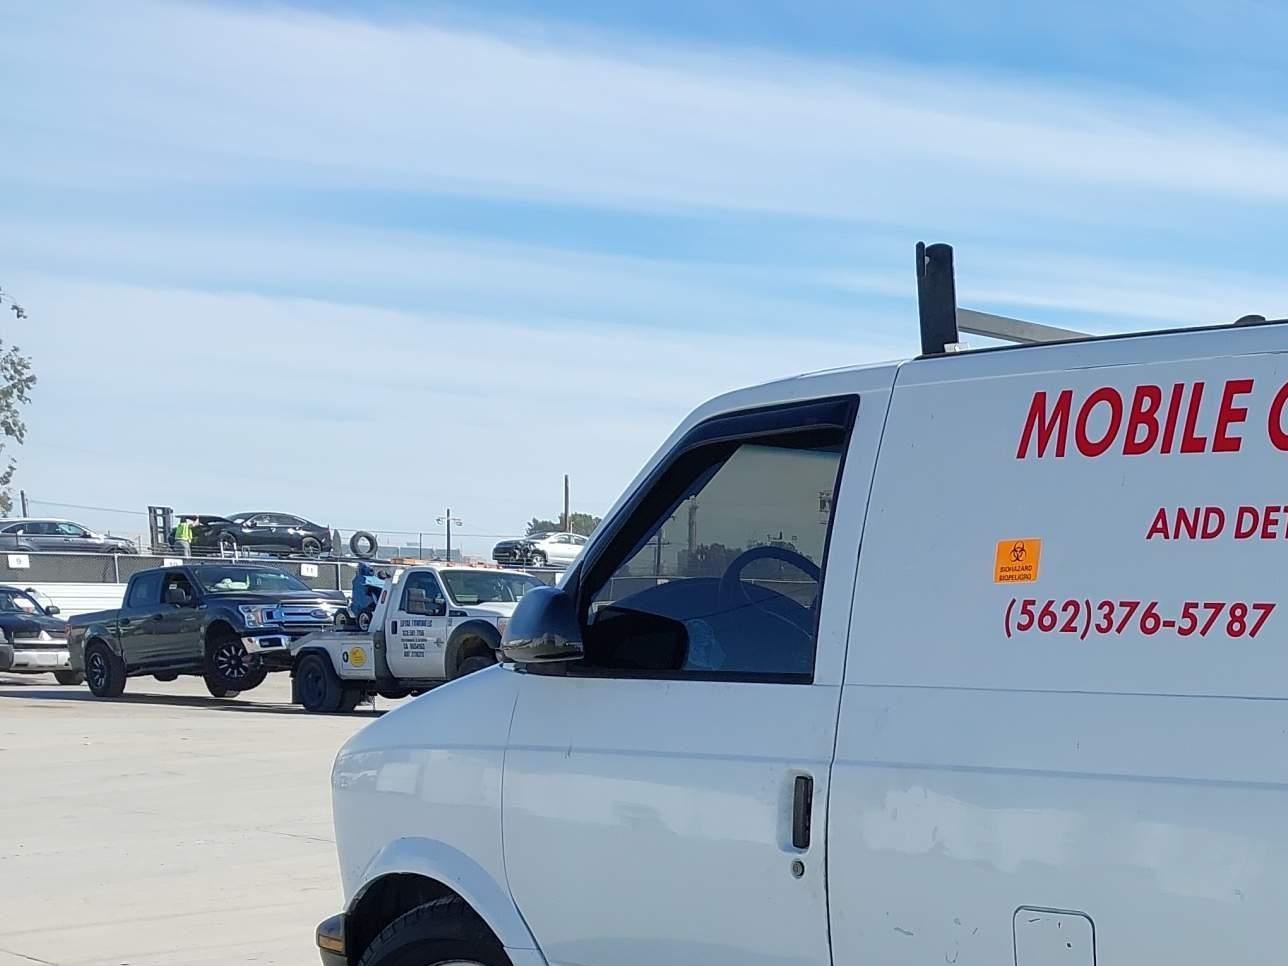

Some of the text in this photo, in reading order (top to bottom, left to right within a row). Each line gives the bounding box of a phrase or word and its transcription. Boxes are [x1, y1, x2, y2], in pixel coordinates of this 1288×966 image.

[1016, 377, 1255, 461] MOBILE
[1146, 507, 1227, 540] AND
[1000, 564, 1033, 573] BIOHAZARD
[1003, 598, 1276, 639] (562)376-5787
